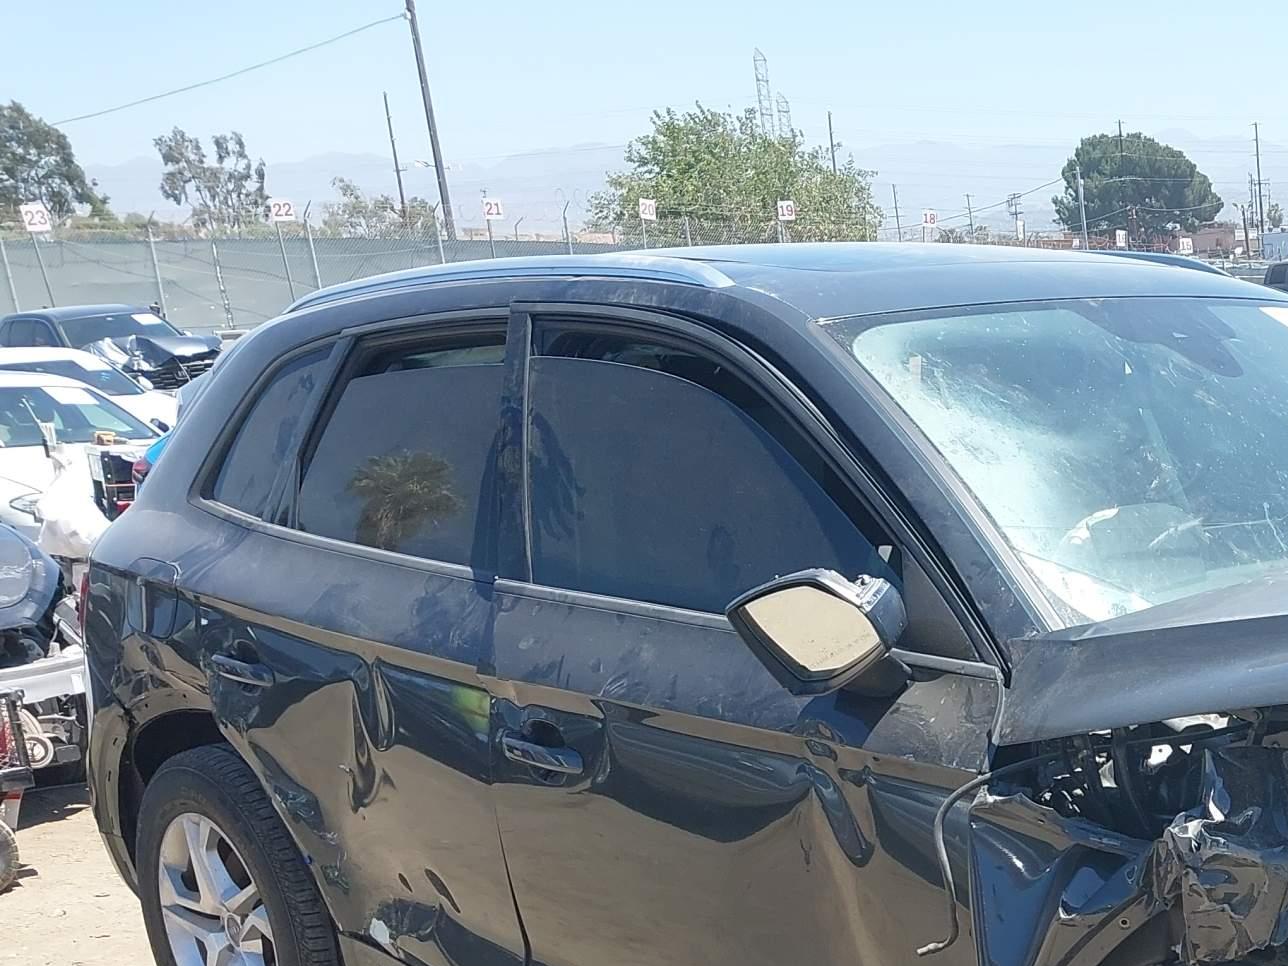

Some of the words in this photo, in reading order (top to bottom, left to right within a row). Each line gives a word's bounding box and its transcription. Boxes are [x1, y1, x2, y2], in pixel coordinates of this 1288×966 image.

[272, 202, 294, 218] 22
[484, 203, 502, 216] 21
[640, 202, 656, 216] 20
[779, 204, 794, 217] 19
[24, 210, 48, 226] 23
[922, 212, 936, 225] 18
[1181, 240, 1192, 250] 15
